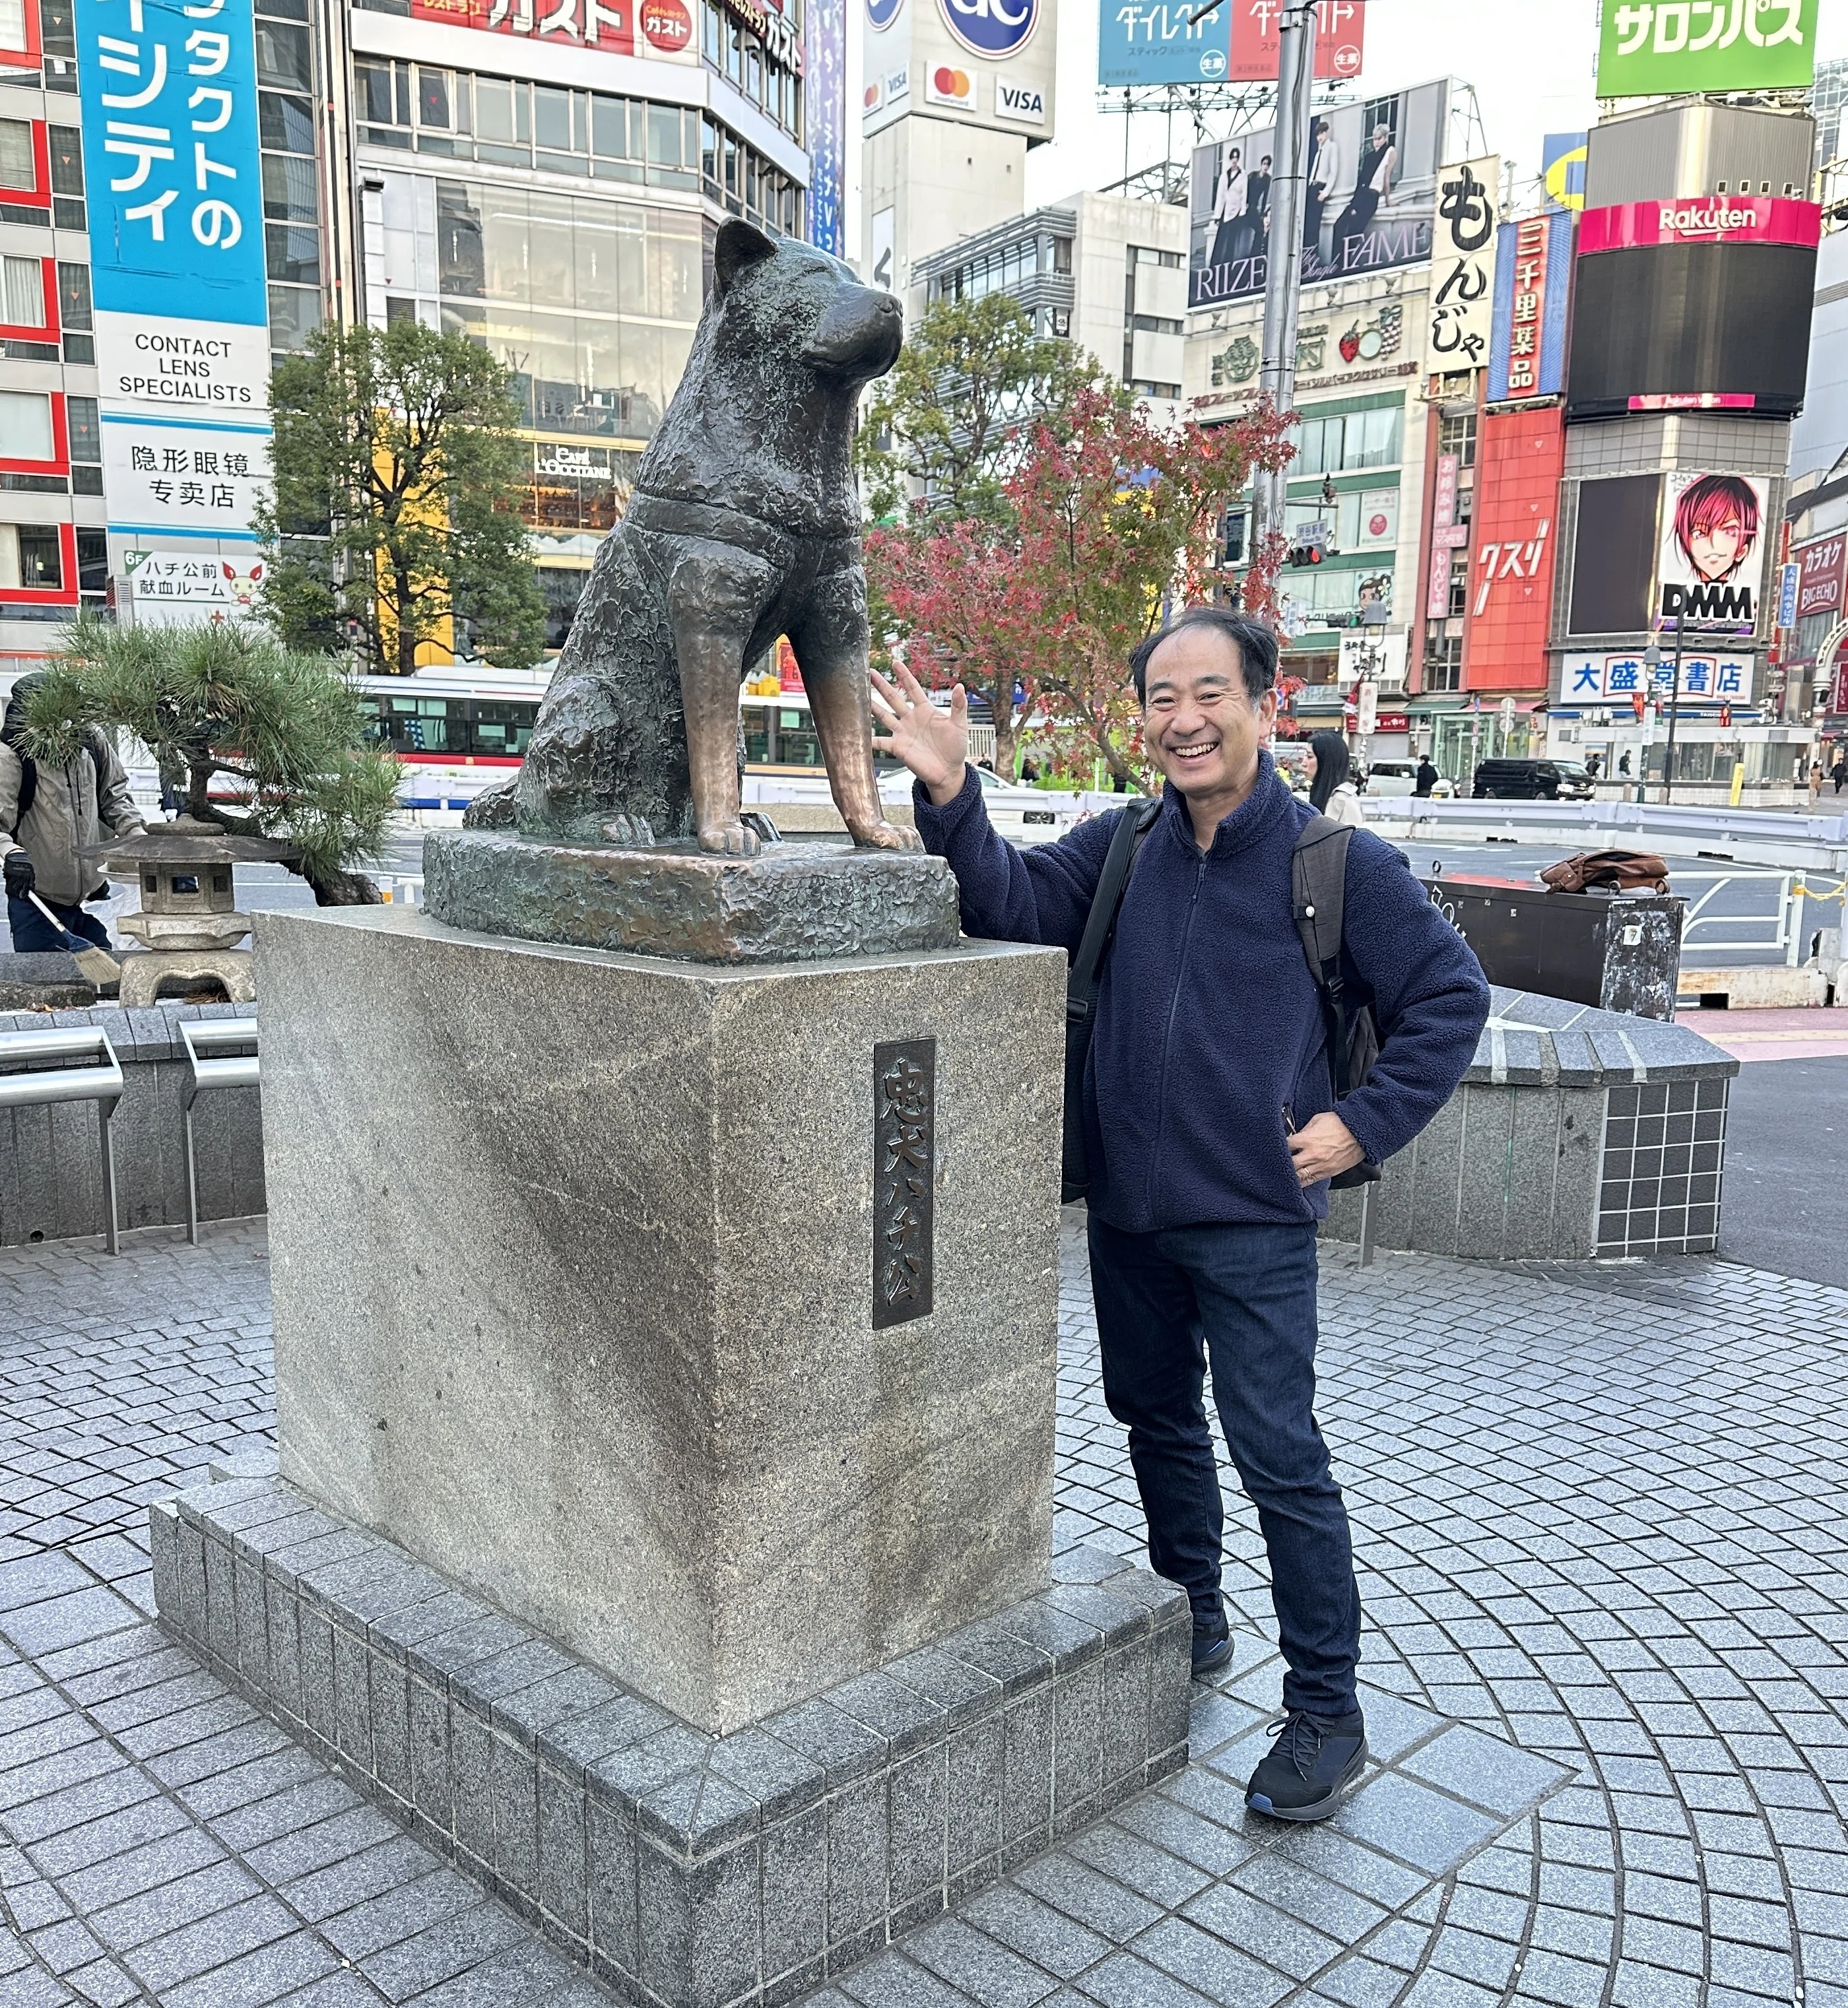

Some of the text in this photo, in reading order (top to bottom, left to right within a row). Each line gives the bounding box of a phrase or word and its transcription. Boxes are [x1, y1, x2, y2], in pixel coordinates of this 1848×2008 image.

[647, 16, 688, 38] ガスト
[1115, 3, 1220, 42] ダイレクト
[1614, 0, 1804, 55] サロンパス
[1127, 46, 1168, 56] スティック
[887, 71, 907, 93] VISA
[999, 86, 1043, 113] VISA
[1659, 206, 1757, 232] Rakuten
[1195, 255, 1267, 301] RIIZE
[1341, 222, 1433, 271] FAME
[1432, 165, 1494, 362] もんじゃ
[1508, 223, 1545, 389] 三千里薬品
[135, 333, 232, 359] CONTACT
[159, 357, 211, 378] LENS
[119, 376, 251, 404] SPECIALISTS
[131, 445, 250, 478] 隐形眼镜
[148, 479, 236, 509] 专卖店
[125, 550, 144, 566] 6F
[145, 560, 218, 579] ハチ公前
[1472, 517, 1551, 617] クスリ
[1804, 540, 1843, 574] カラオケ
[139, 579, 226, 599] 献血ルーム
[1661, 583, 1753, 620] DMM
[1800, 579, 1838, 611] BIG ECHO
[1572, 661, 1743, 692] 大盛堂書店
[880, 1057, 929, 1307] 忠犬ハチ公
